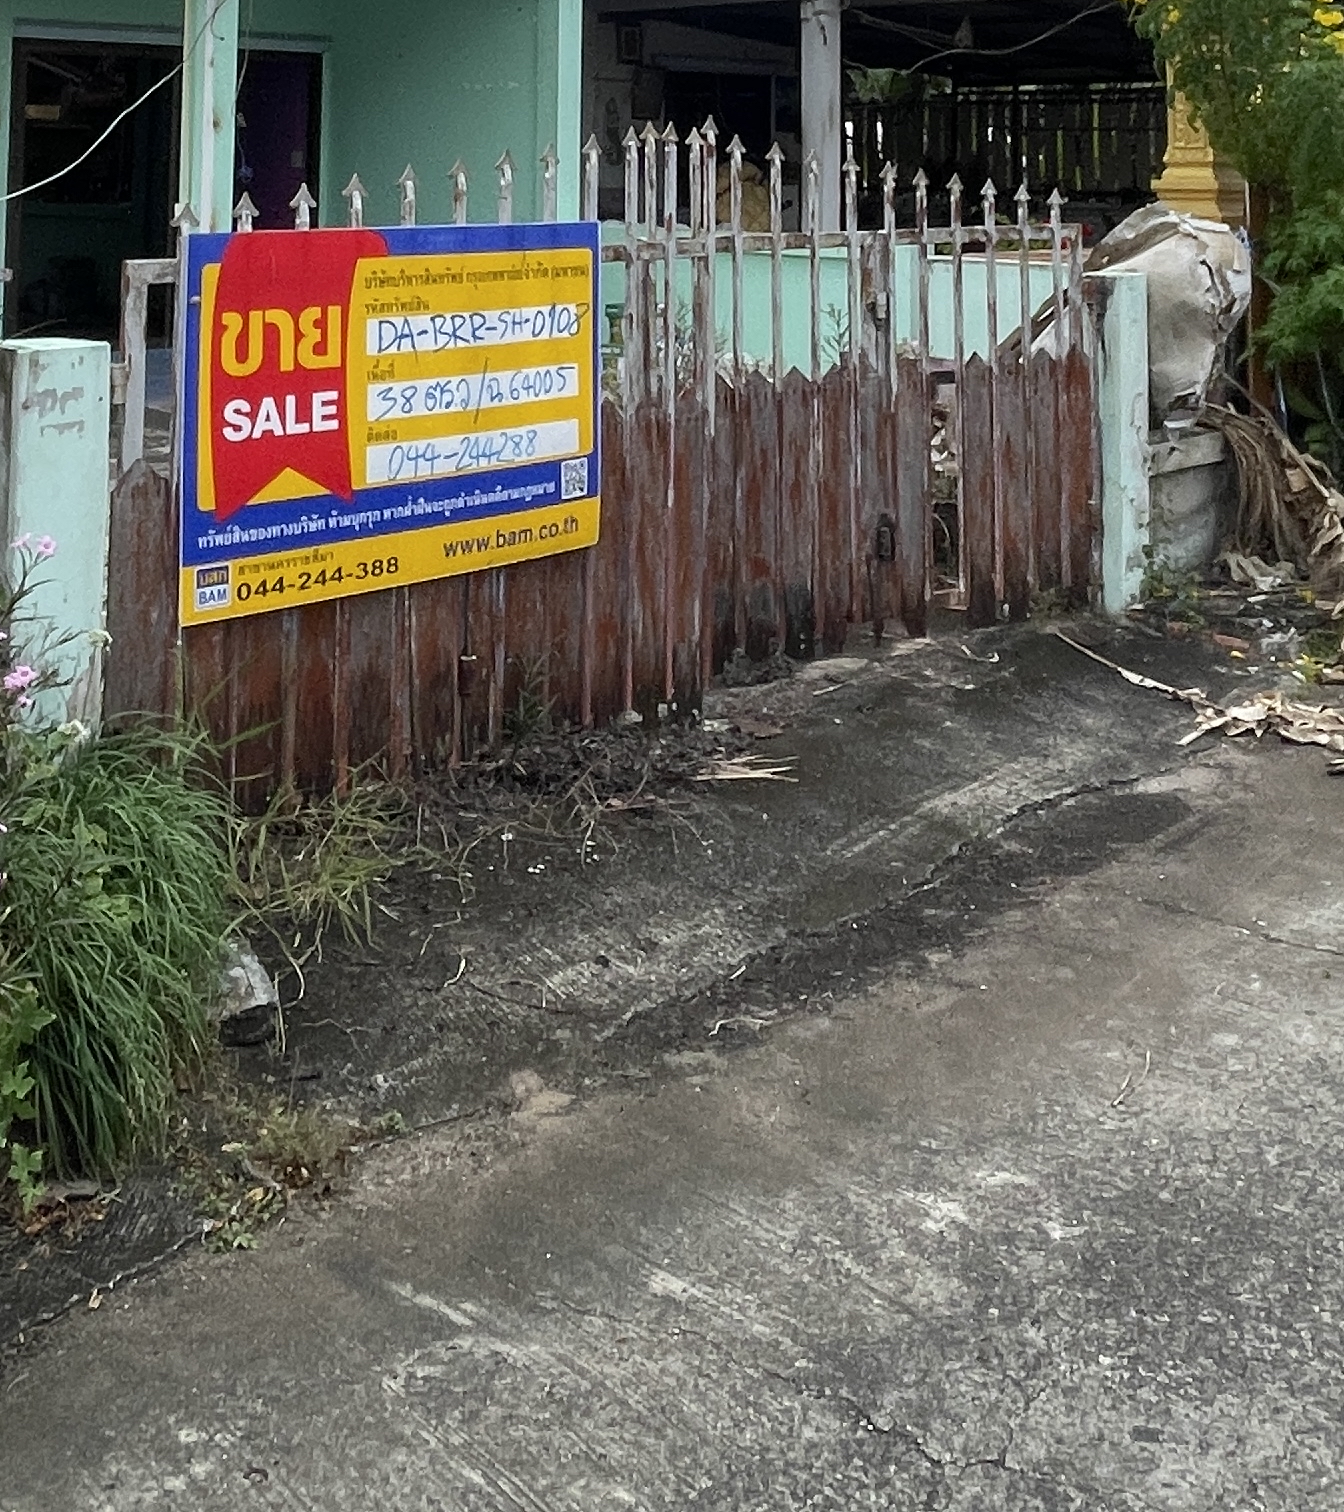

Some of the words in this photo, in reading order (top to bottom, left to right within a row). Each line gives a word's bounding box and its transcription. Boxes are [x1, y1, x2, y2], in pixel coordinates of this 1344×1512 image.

[221, 305, 342, 377] ขาย
[222, 390, 339, 442] SALE
[367, 424, 398, 443] ติดต่อ
[443, 514, 578, 558] www.bam.co.th
[198, 588, 227, 606] BAM
[236, 556, 400, 602] 044-244-388
